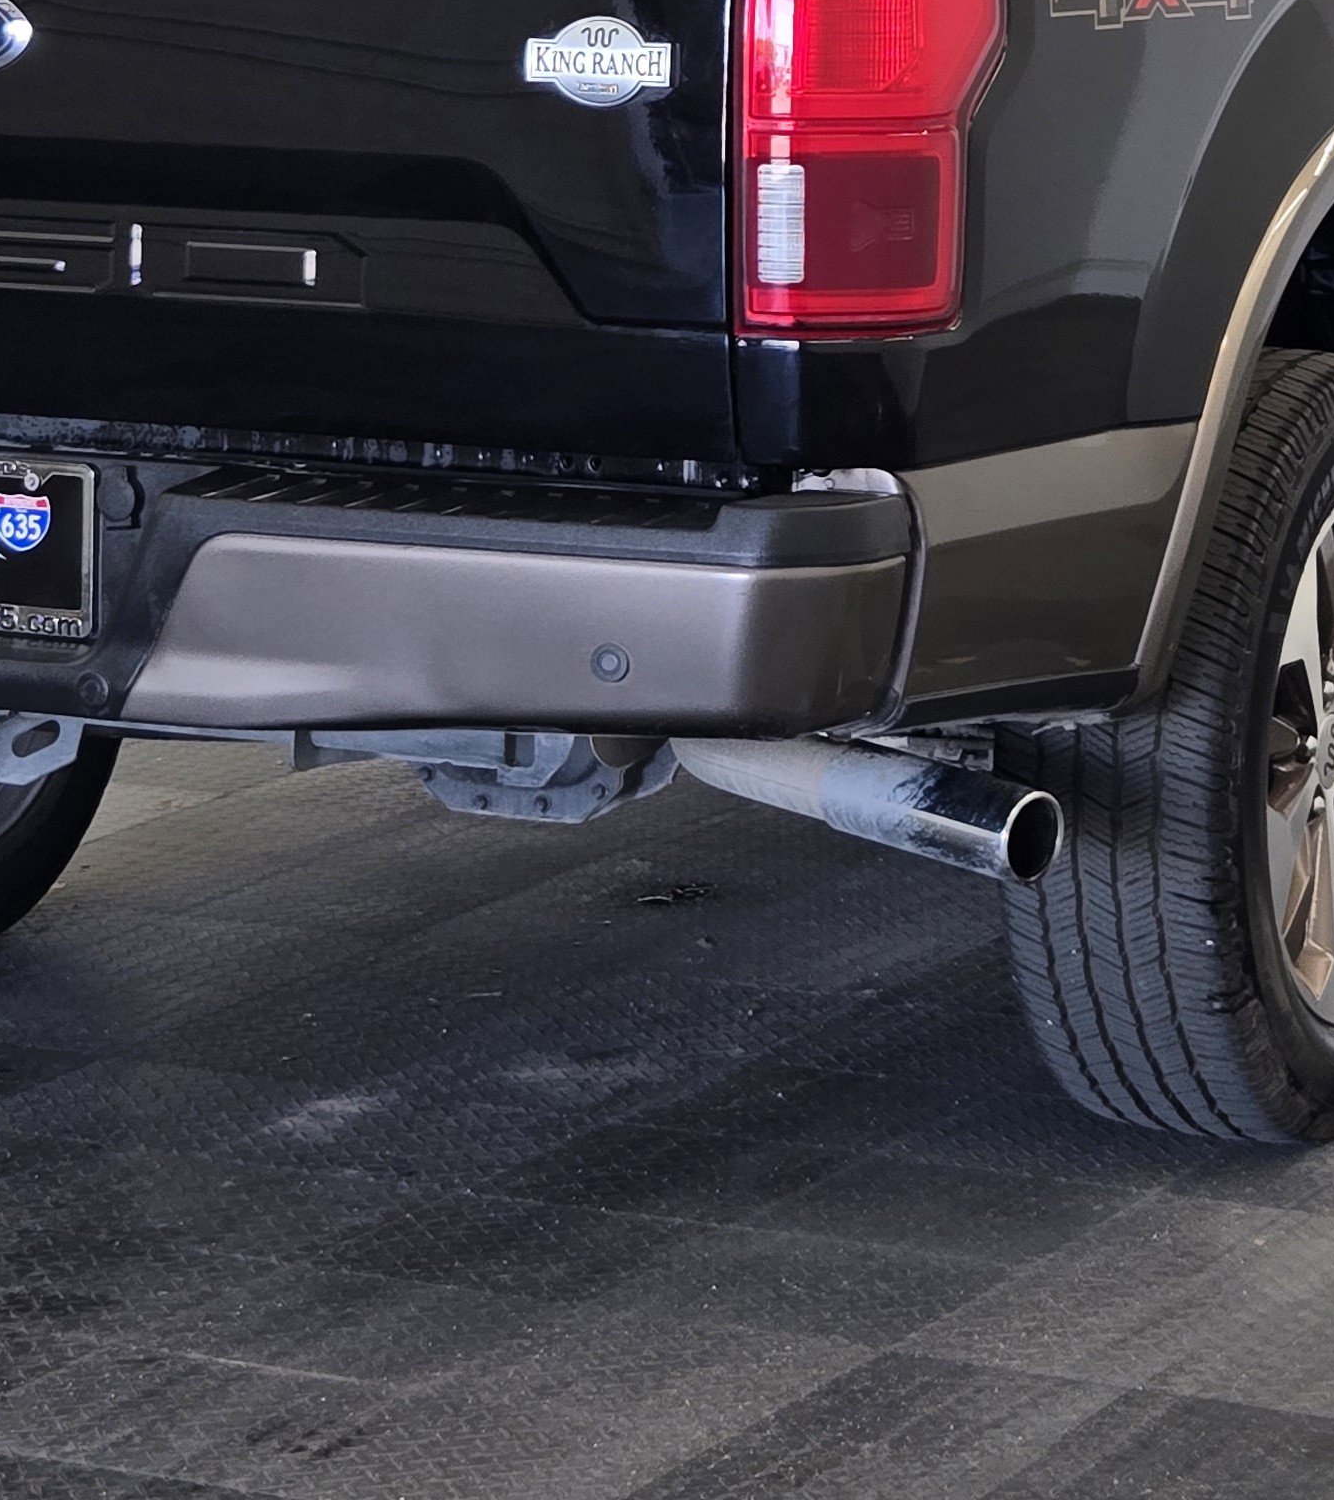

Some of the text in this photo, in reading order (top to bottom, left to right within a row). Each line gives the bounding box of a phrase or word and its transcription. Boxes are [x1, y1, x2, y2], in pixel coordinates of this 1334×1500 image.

[535, 46, 662, 77] KING RANCH
[1, 513, 41, 540] 635
